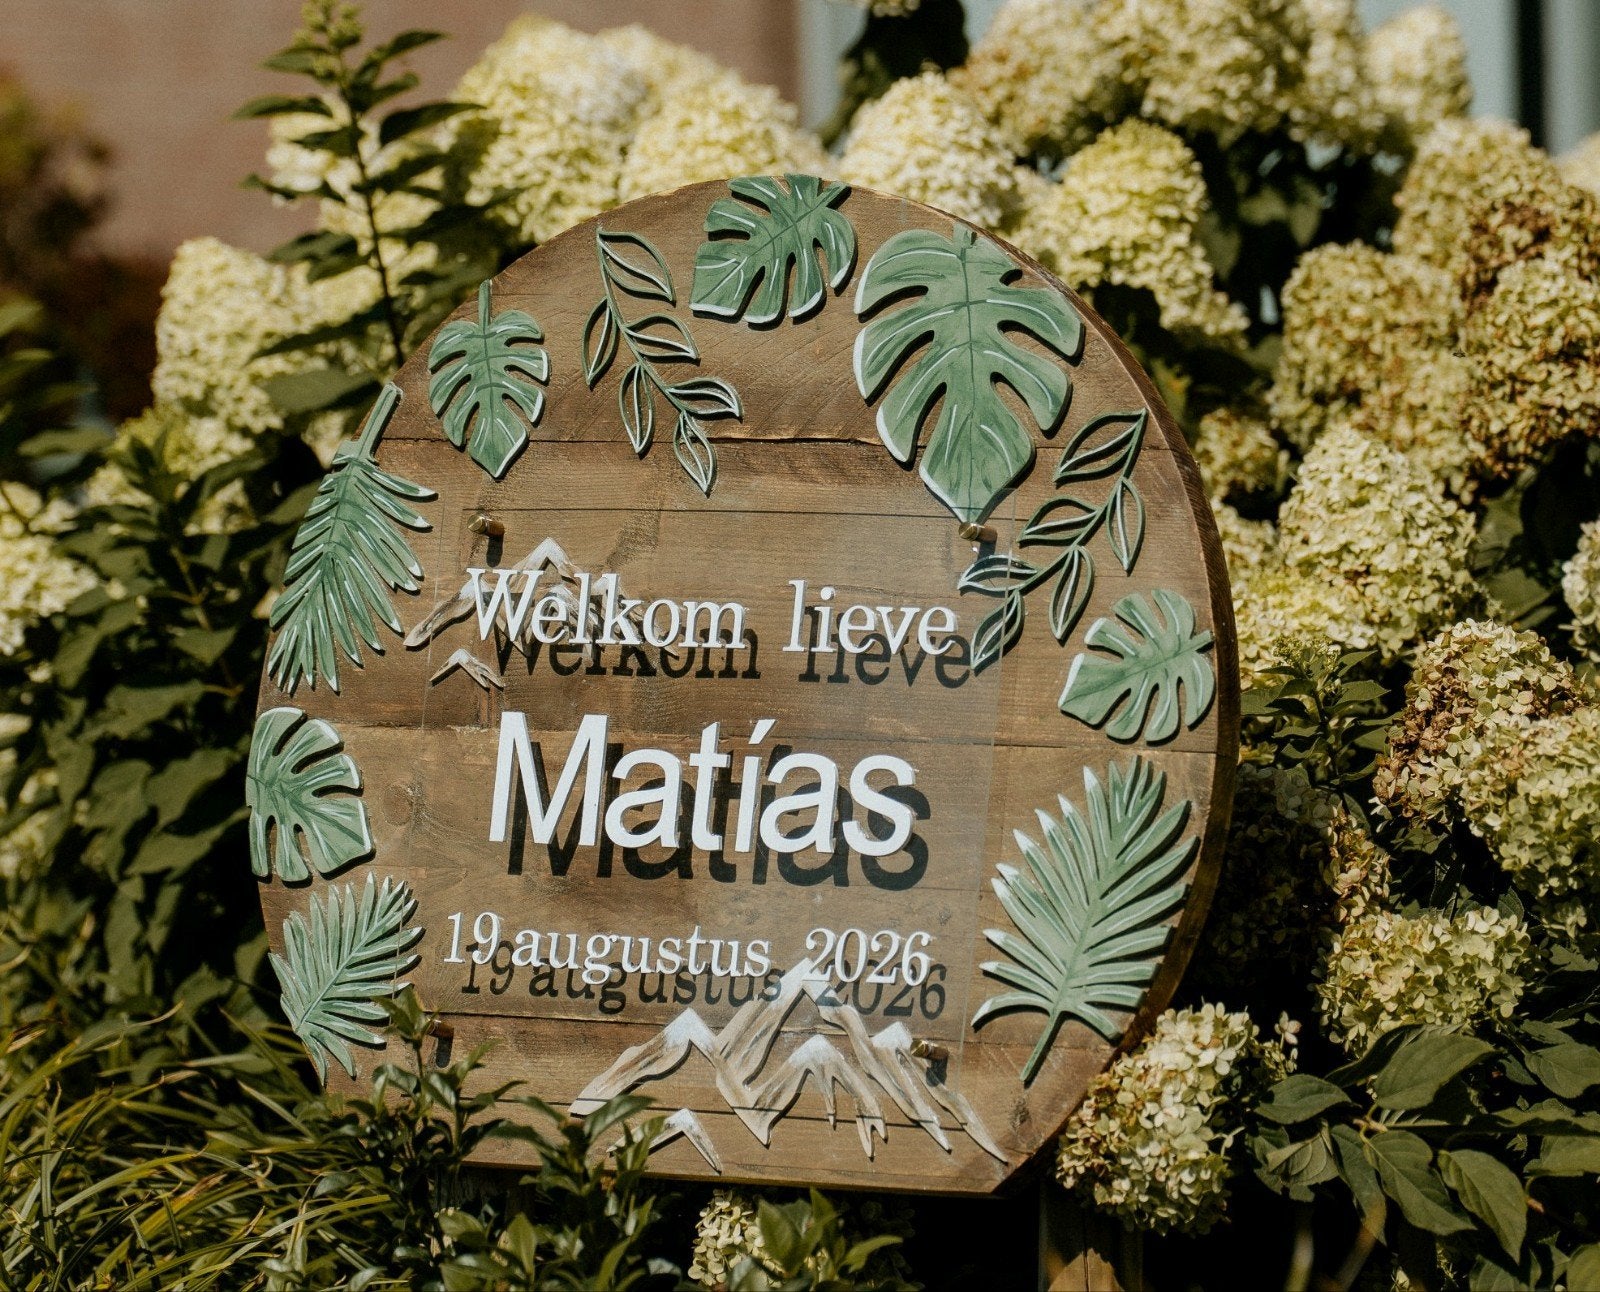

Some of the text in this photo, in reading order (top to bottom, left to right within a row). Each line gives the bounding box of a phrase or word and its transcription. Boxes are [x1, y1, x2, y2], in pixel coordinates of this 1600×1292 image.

[466, 567, 959, 655] Welkom lieve
[488, 711, 918, 856] Matías
[802, 927, 933, 987] 2026
